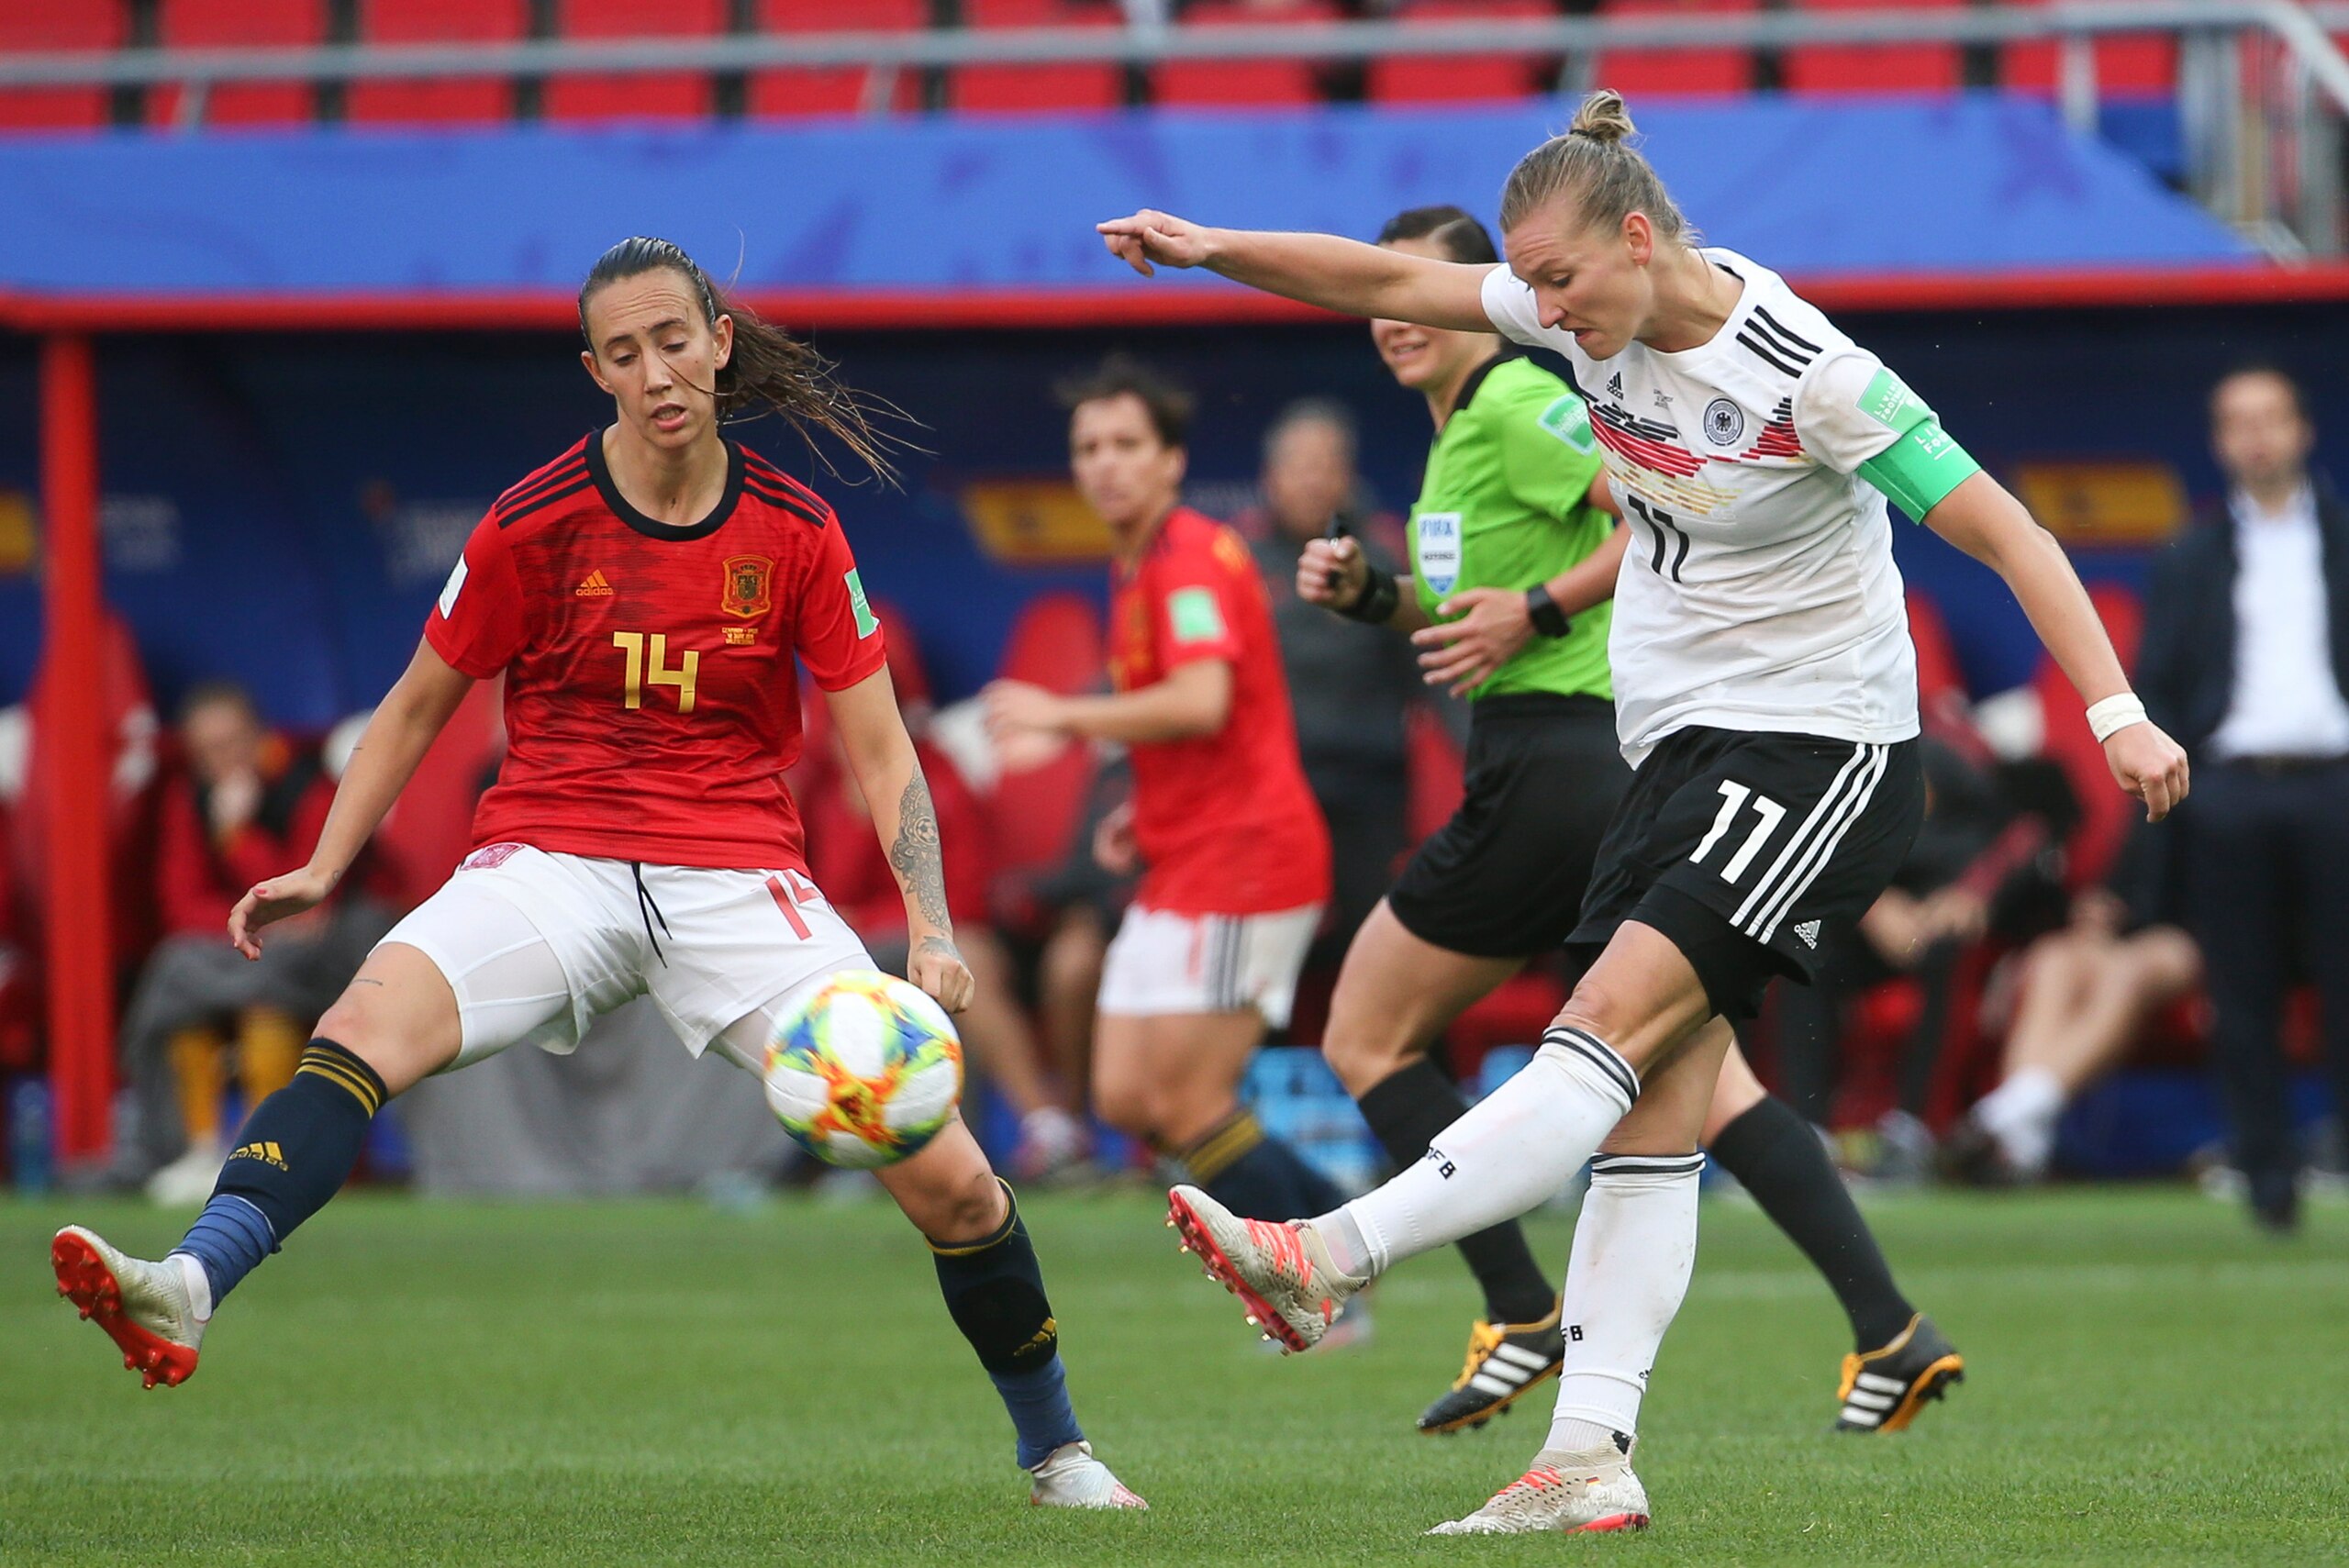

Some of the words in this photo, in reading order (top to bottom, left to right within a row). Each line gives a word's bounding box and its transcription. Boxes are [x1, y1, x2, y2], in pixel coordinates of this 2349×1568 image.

[1627, 494, 1689, 584] 11
[575, 586, 614, 595] adidas
[613, 630, 699, 714] 14
[1688, 779, 1787, 884] 11
